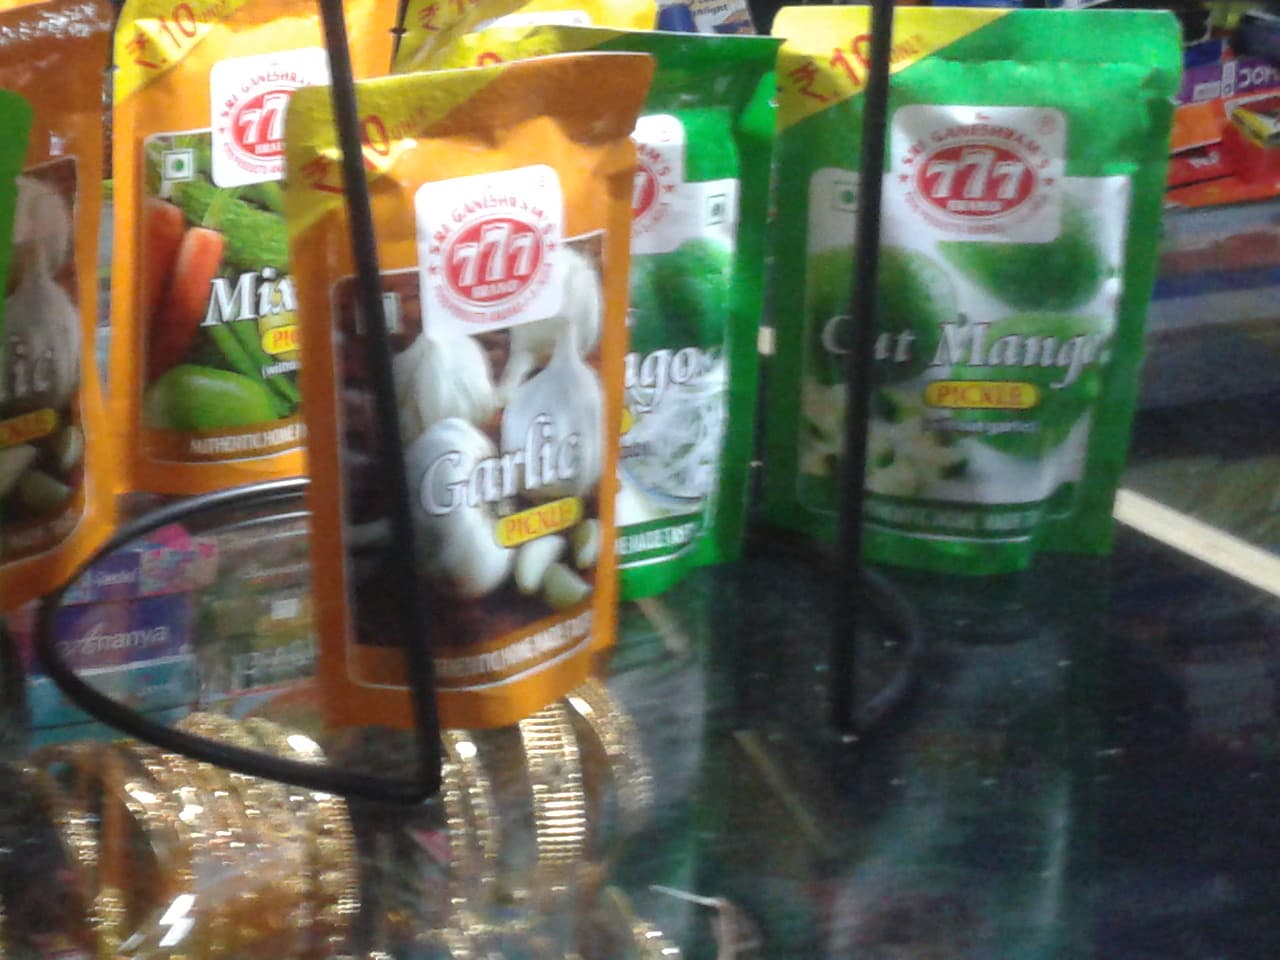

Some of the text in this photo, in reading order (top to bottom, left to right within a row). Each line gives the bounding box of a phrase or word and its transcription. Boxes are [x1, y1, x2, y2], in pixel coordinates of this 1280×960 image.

[157, 2, 197, 49] 10
[238, 92, 290, 145] 77
[925, 148, 1026, 200] 777
[453, 221, 536, 289] 777
[420, 412, 580, 517] Garlic
